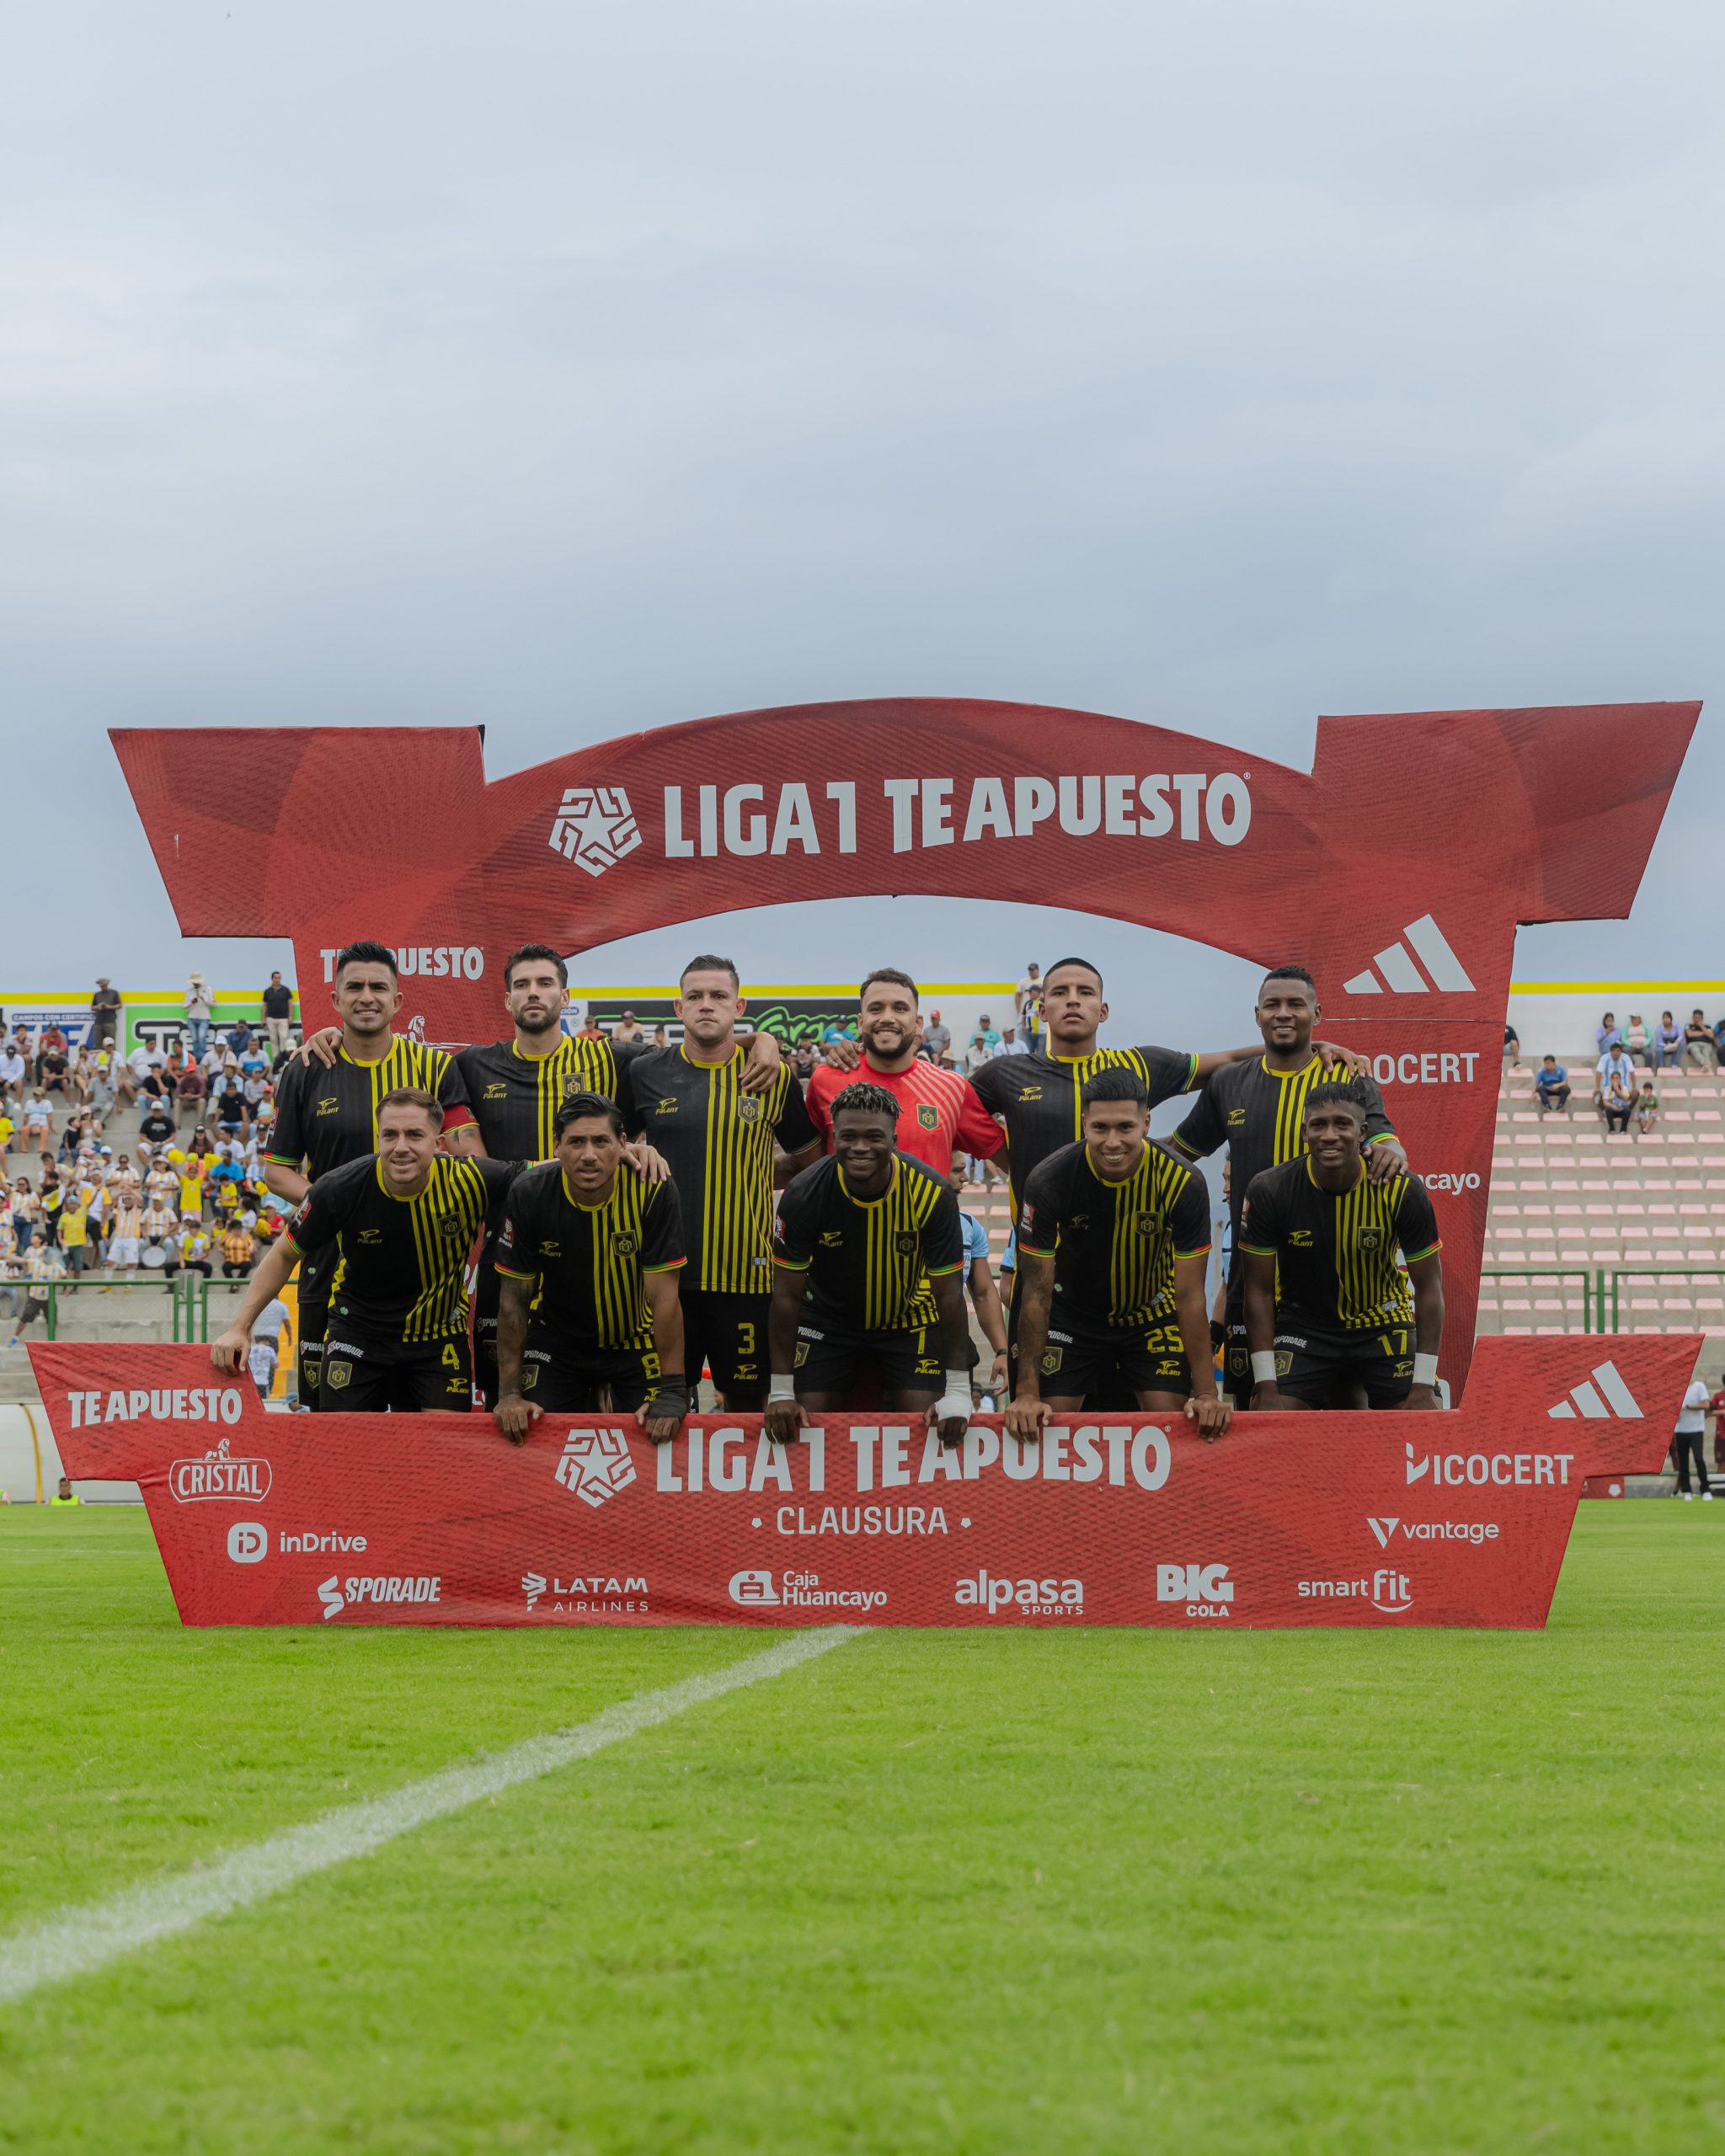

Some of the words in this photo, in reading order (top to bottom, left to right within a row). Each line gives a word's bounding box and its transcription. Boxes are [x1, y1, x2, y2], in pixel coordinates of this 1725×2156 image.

[963, 772, 1252, 846] APUESTO
[1363, 1053, 1480, 1084] OCERT
[737, 1322, 755, 1354] 3
[798, 1326, 825, 1340] PORADE
[1048, 1330, 1074, 1344] PORADE
[1144, 1325, 1184, 1353] 25
[1377, 1329, 1408, 1356] 17
[334, 1342, 365, 1358] SPORADE
[441, 1342, 460, 1370] 4
[104, 1388, 243, 1424] APUESTO
[918, 1425, 1171, 1491] APUESTO
[178, 1465, 263, 1496] CRISTAL
[777, 1506, 948, 1534] CLAUSURA
[1402, 1520, 1499, 1545] vantage
[280, 1531, 367, 1553] inDrive
[345, 1577, 441, 1603] SPORADE
[553, 1577, 649, 1593] LATAM
[782, 1570, 819, 1590] Caja
[954, 1569, 1084, 1614] alpasa
[1156, 1563, 1234, 1602] BIG
[1297, 1577, 1368, 1597] smart
[1372, 1569, 1411, 1600] fit
[553, 1601, 649, 1612] AIRLINES
[782, 1587, 887, 1611] Huancayo
[1022, 1604, 1084, 1615] SPORTS
[1186, 1604, 1230, 1617] COLA
